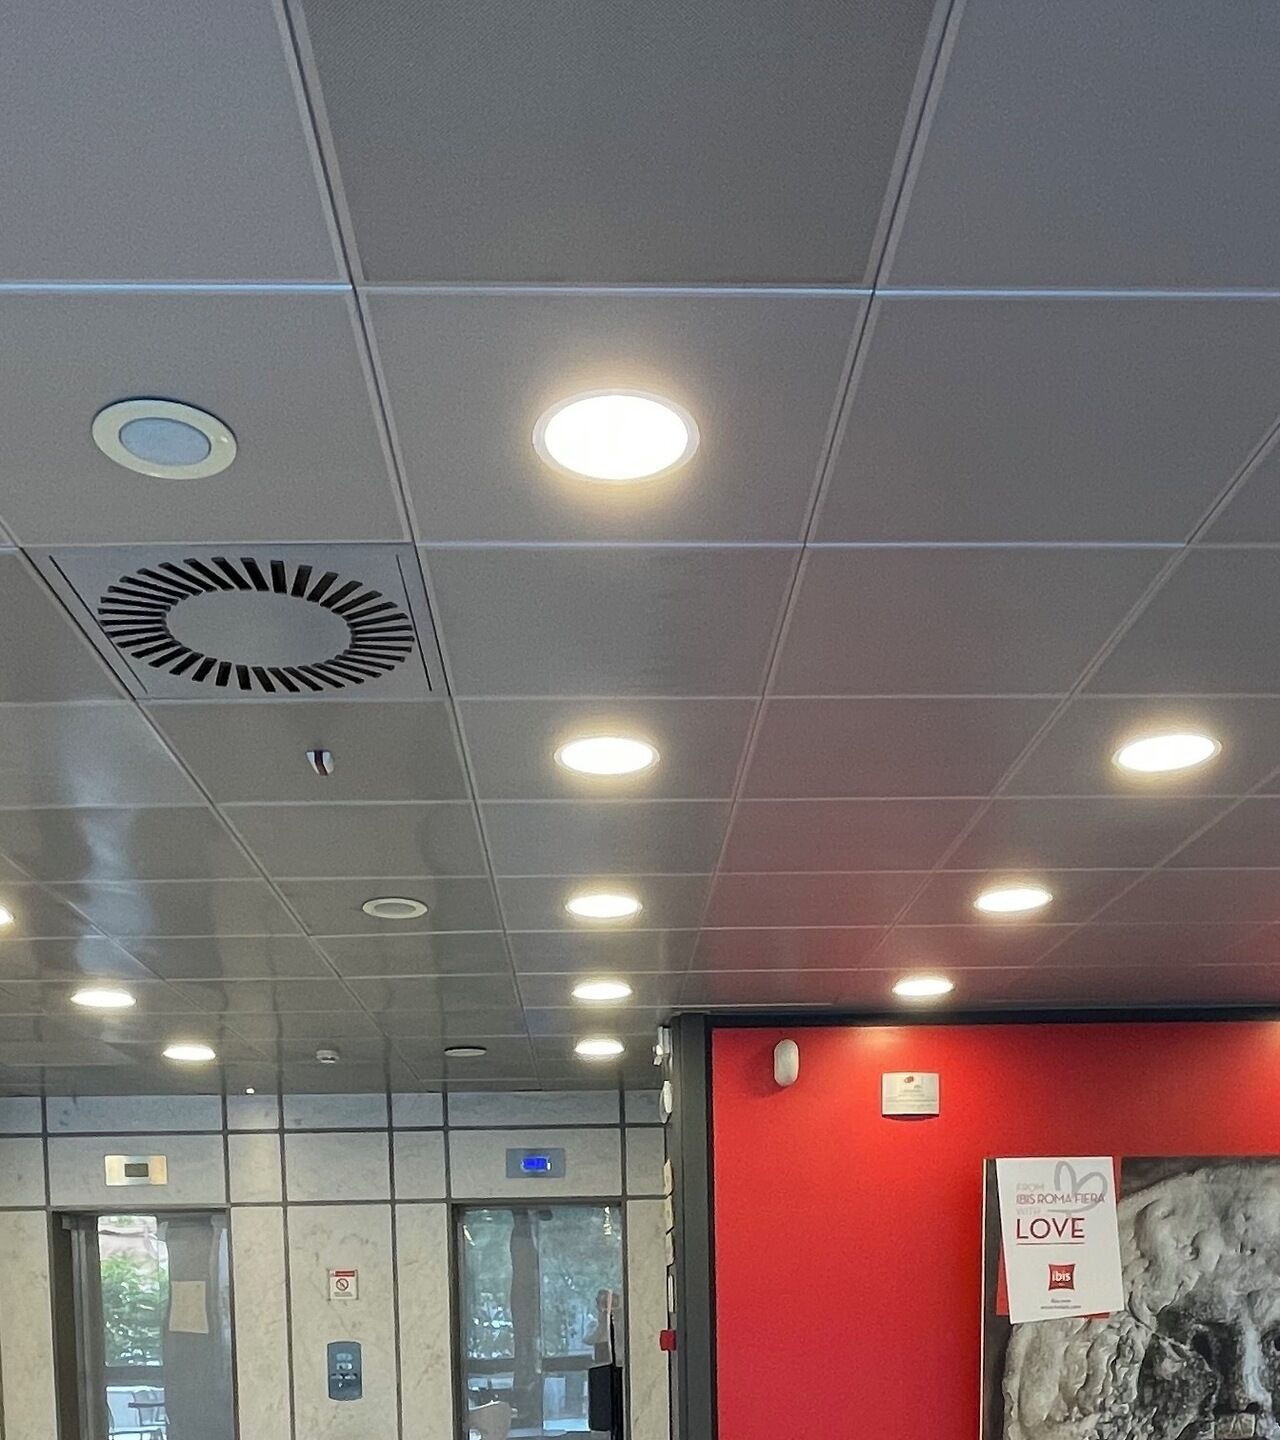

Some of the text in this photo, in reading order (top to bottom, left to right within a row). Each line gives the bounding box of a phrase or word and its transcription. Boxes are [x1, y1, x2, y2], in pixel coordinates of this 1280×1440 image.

[1016, 1192, 1105, 1205] IBIS ROMA FIERA
[1016, 1217, 1085, 1240] LOVE
[1051, 1269, 1072, 1283] ibis
